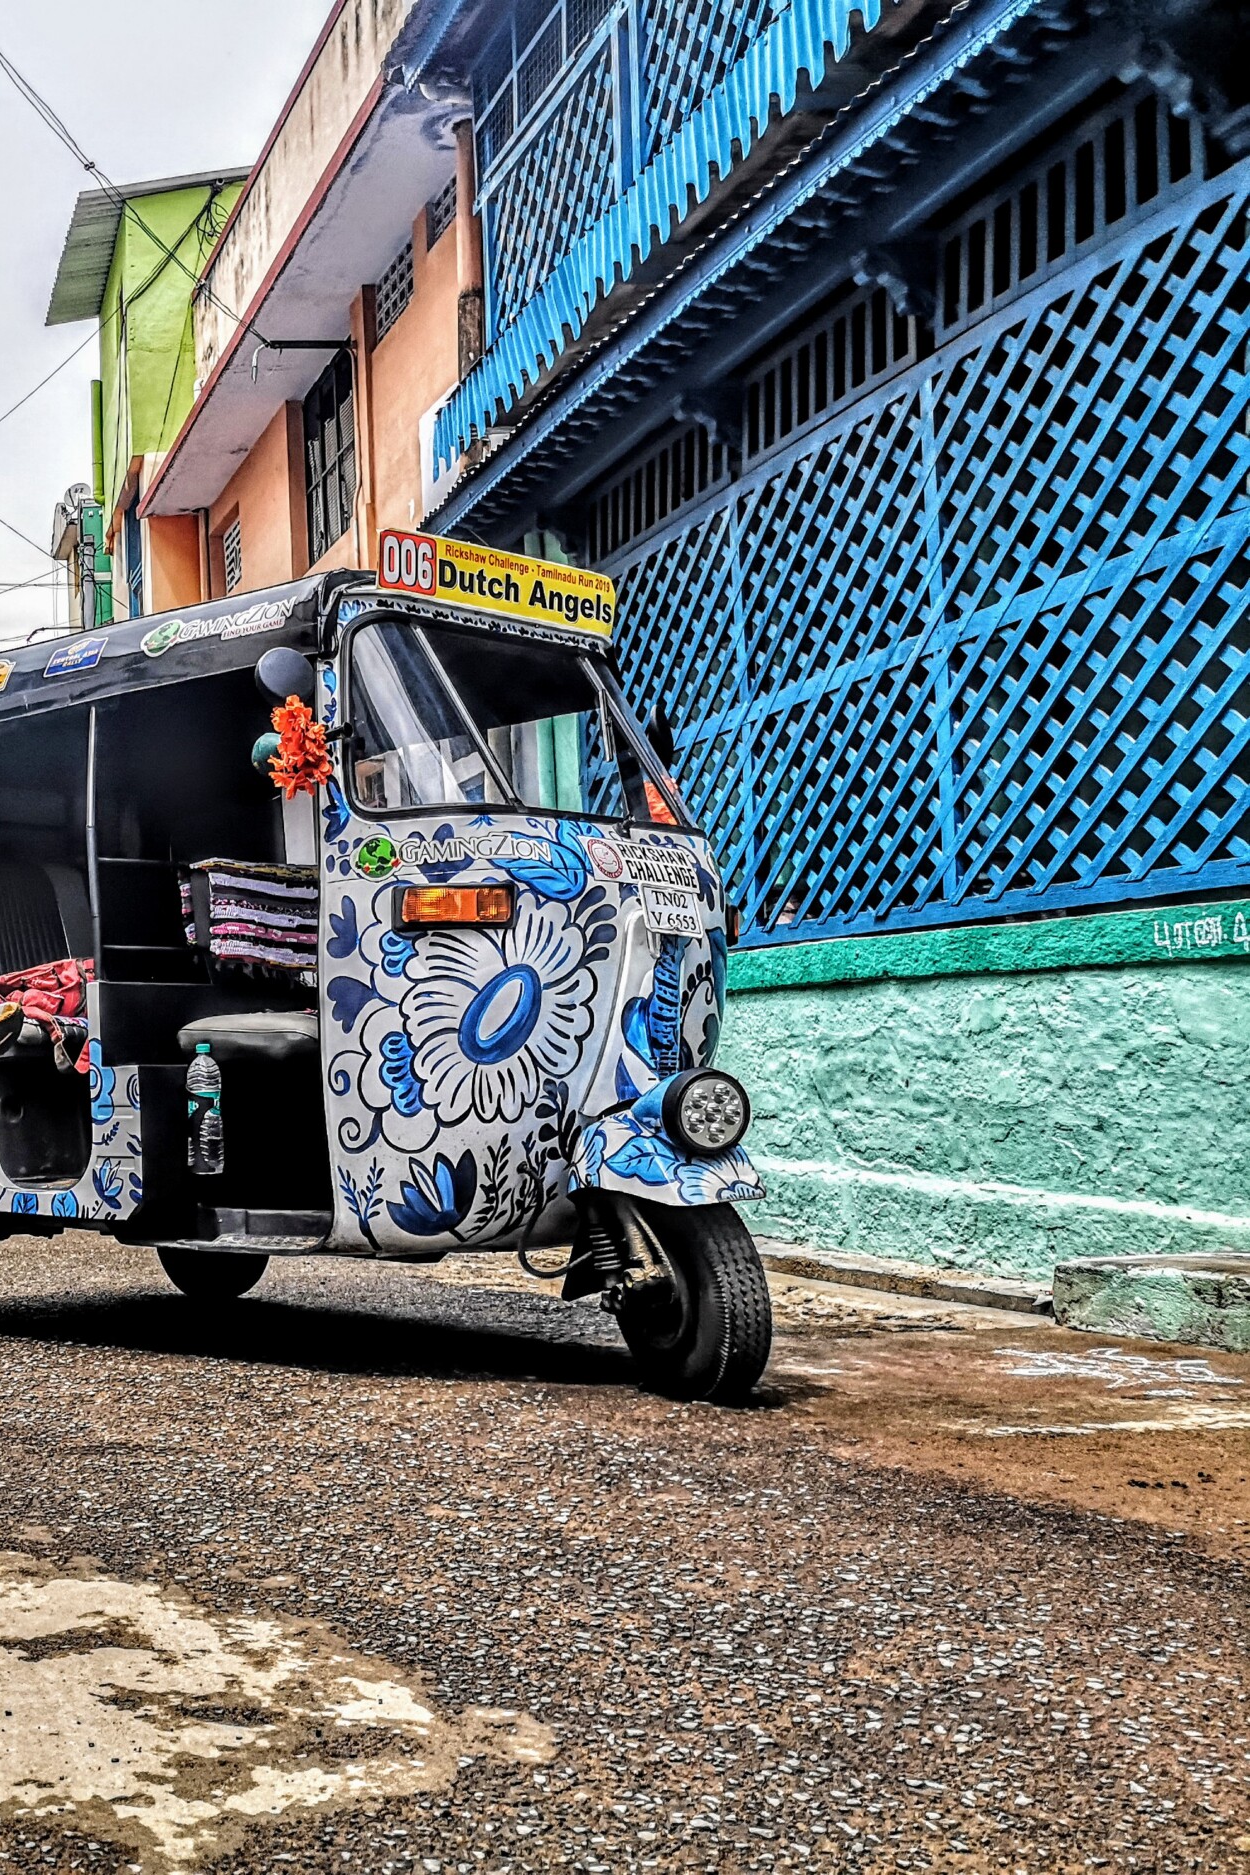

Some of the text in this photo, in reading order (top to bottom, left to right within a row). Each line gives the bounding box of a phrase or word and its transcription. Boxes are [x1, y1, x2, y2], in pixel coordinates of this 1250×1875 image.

[382, 534, 434, 590] 006
[444, 543, 487, 565] Rickshaw
[488, 554, 530, 575] Challenge
[536, 564, 578, 585] Tamilnadu
[578, 576, 594, 588] Run
[595, 580, 611, 594] 2019
[438, 559, 613, 624] Dutch Angels
[179, 597, 297, 639] GAMINGZION
[223, 618, 284, 638] FIND YOUR GAME
[400, 834, 551, 863] GAMINGZION
[616, 843, 688, 866] RICKSHAW
[625, 860, 697, 888] CHALLENGE
[651, 890, 688, 909] TN02
[651, 911, 697, 931] V 6553
